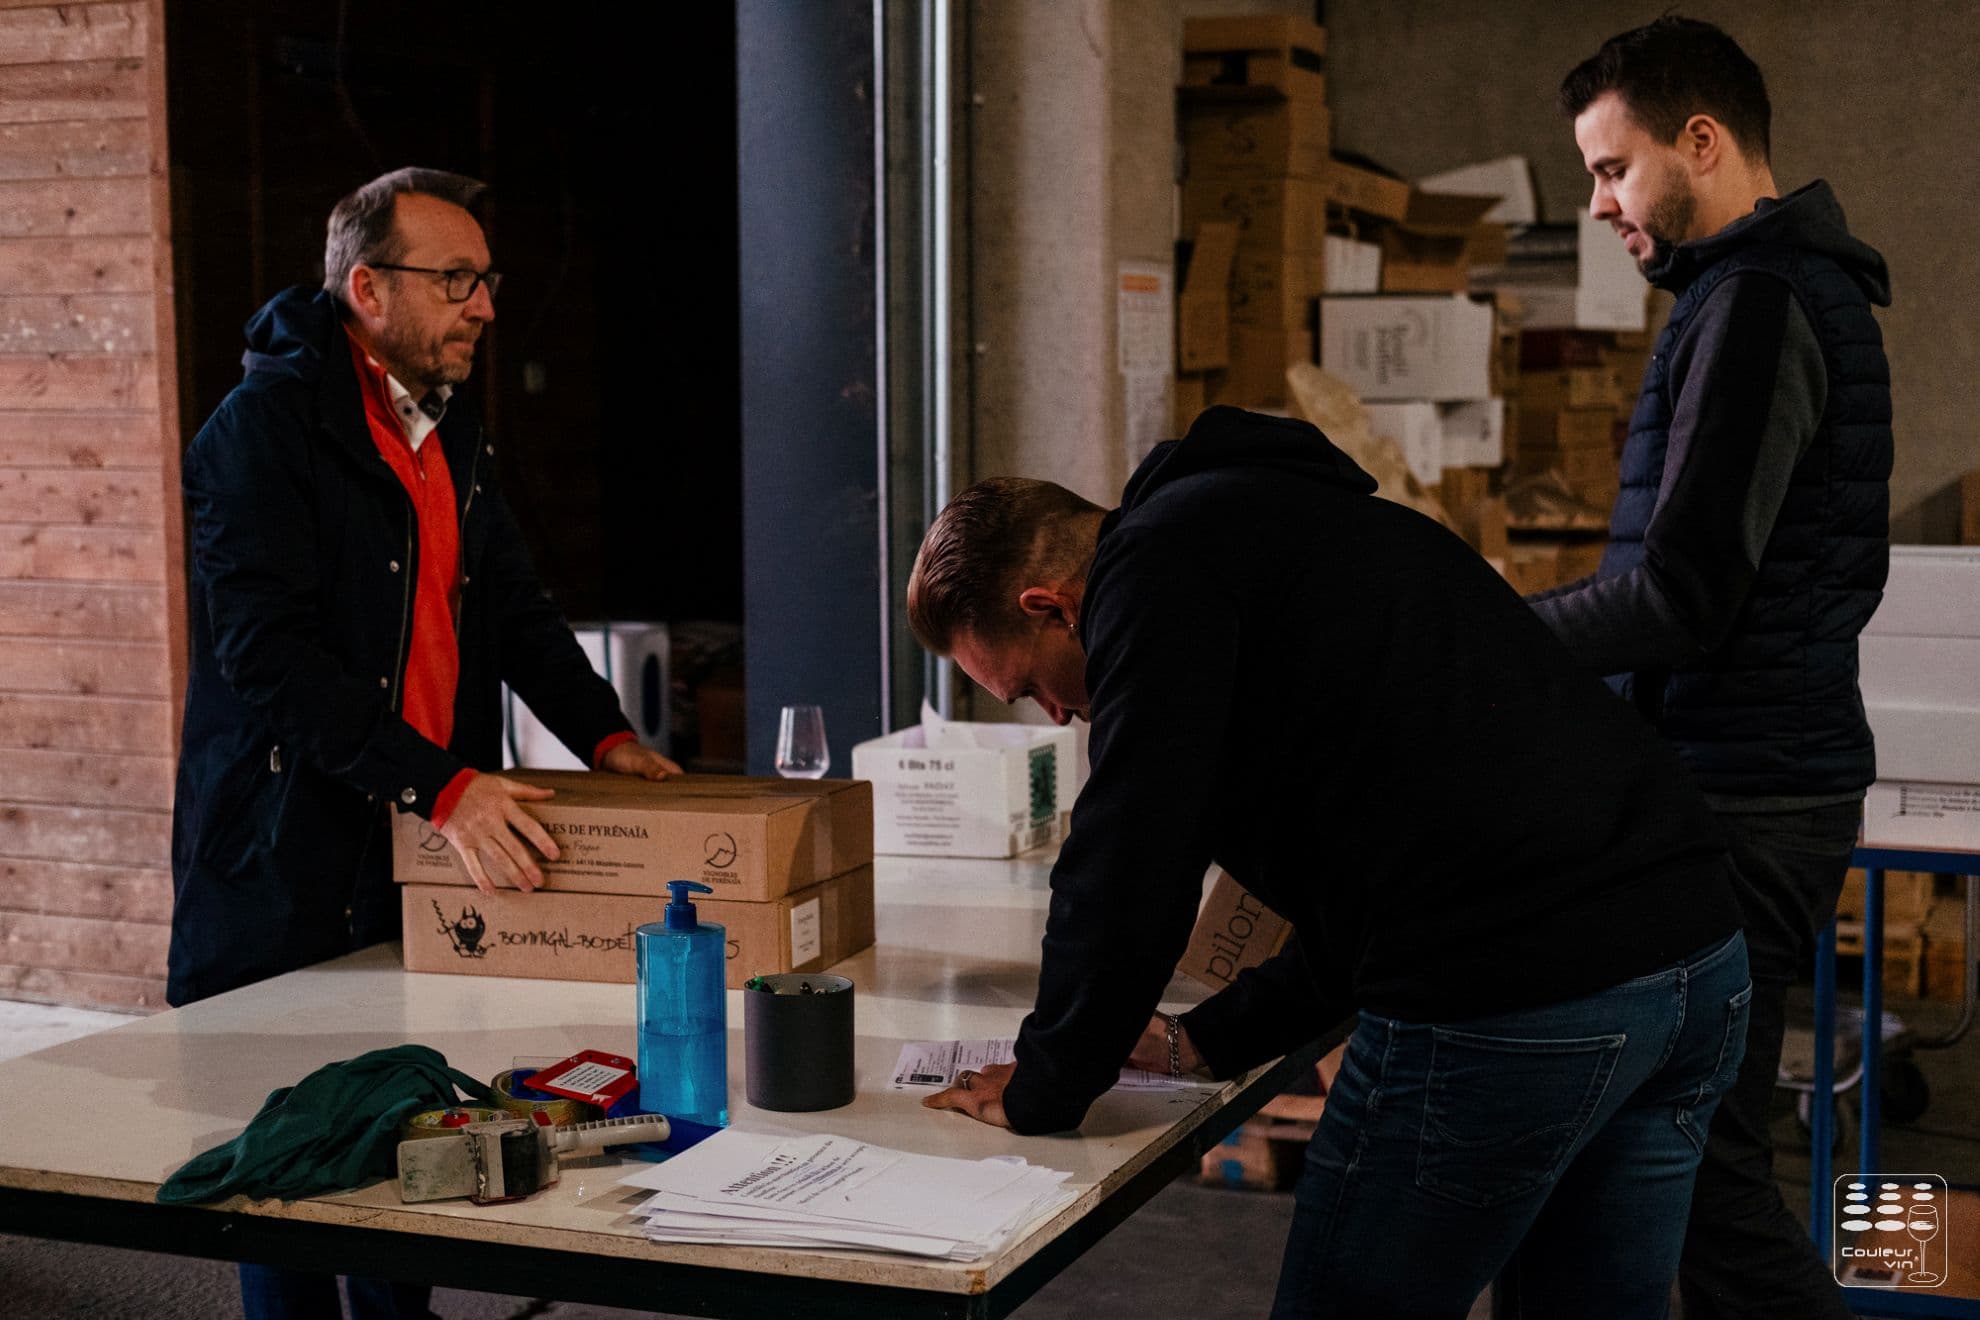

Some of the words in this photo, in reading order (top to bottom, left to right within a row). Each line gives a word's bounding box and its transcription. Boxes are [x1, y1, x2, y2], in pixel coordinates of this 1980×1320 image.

[569, 824, 586, 835] DE
[589, 825, 649, 839] PYRÉNAÏA
[720, 1166, 782, 1195] Attention
